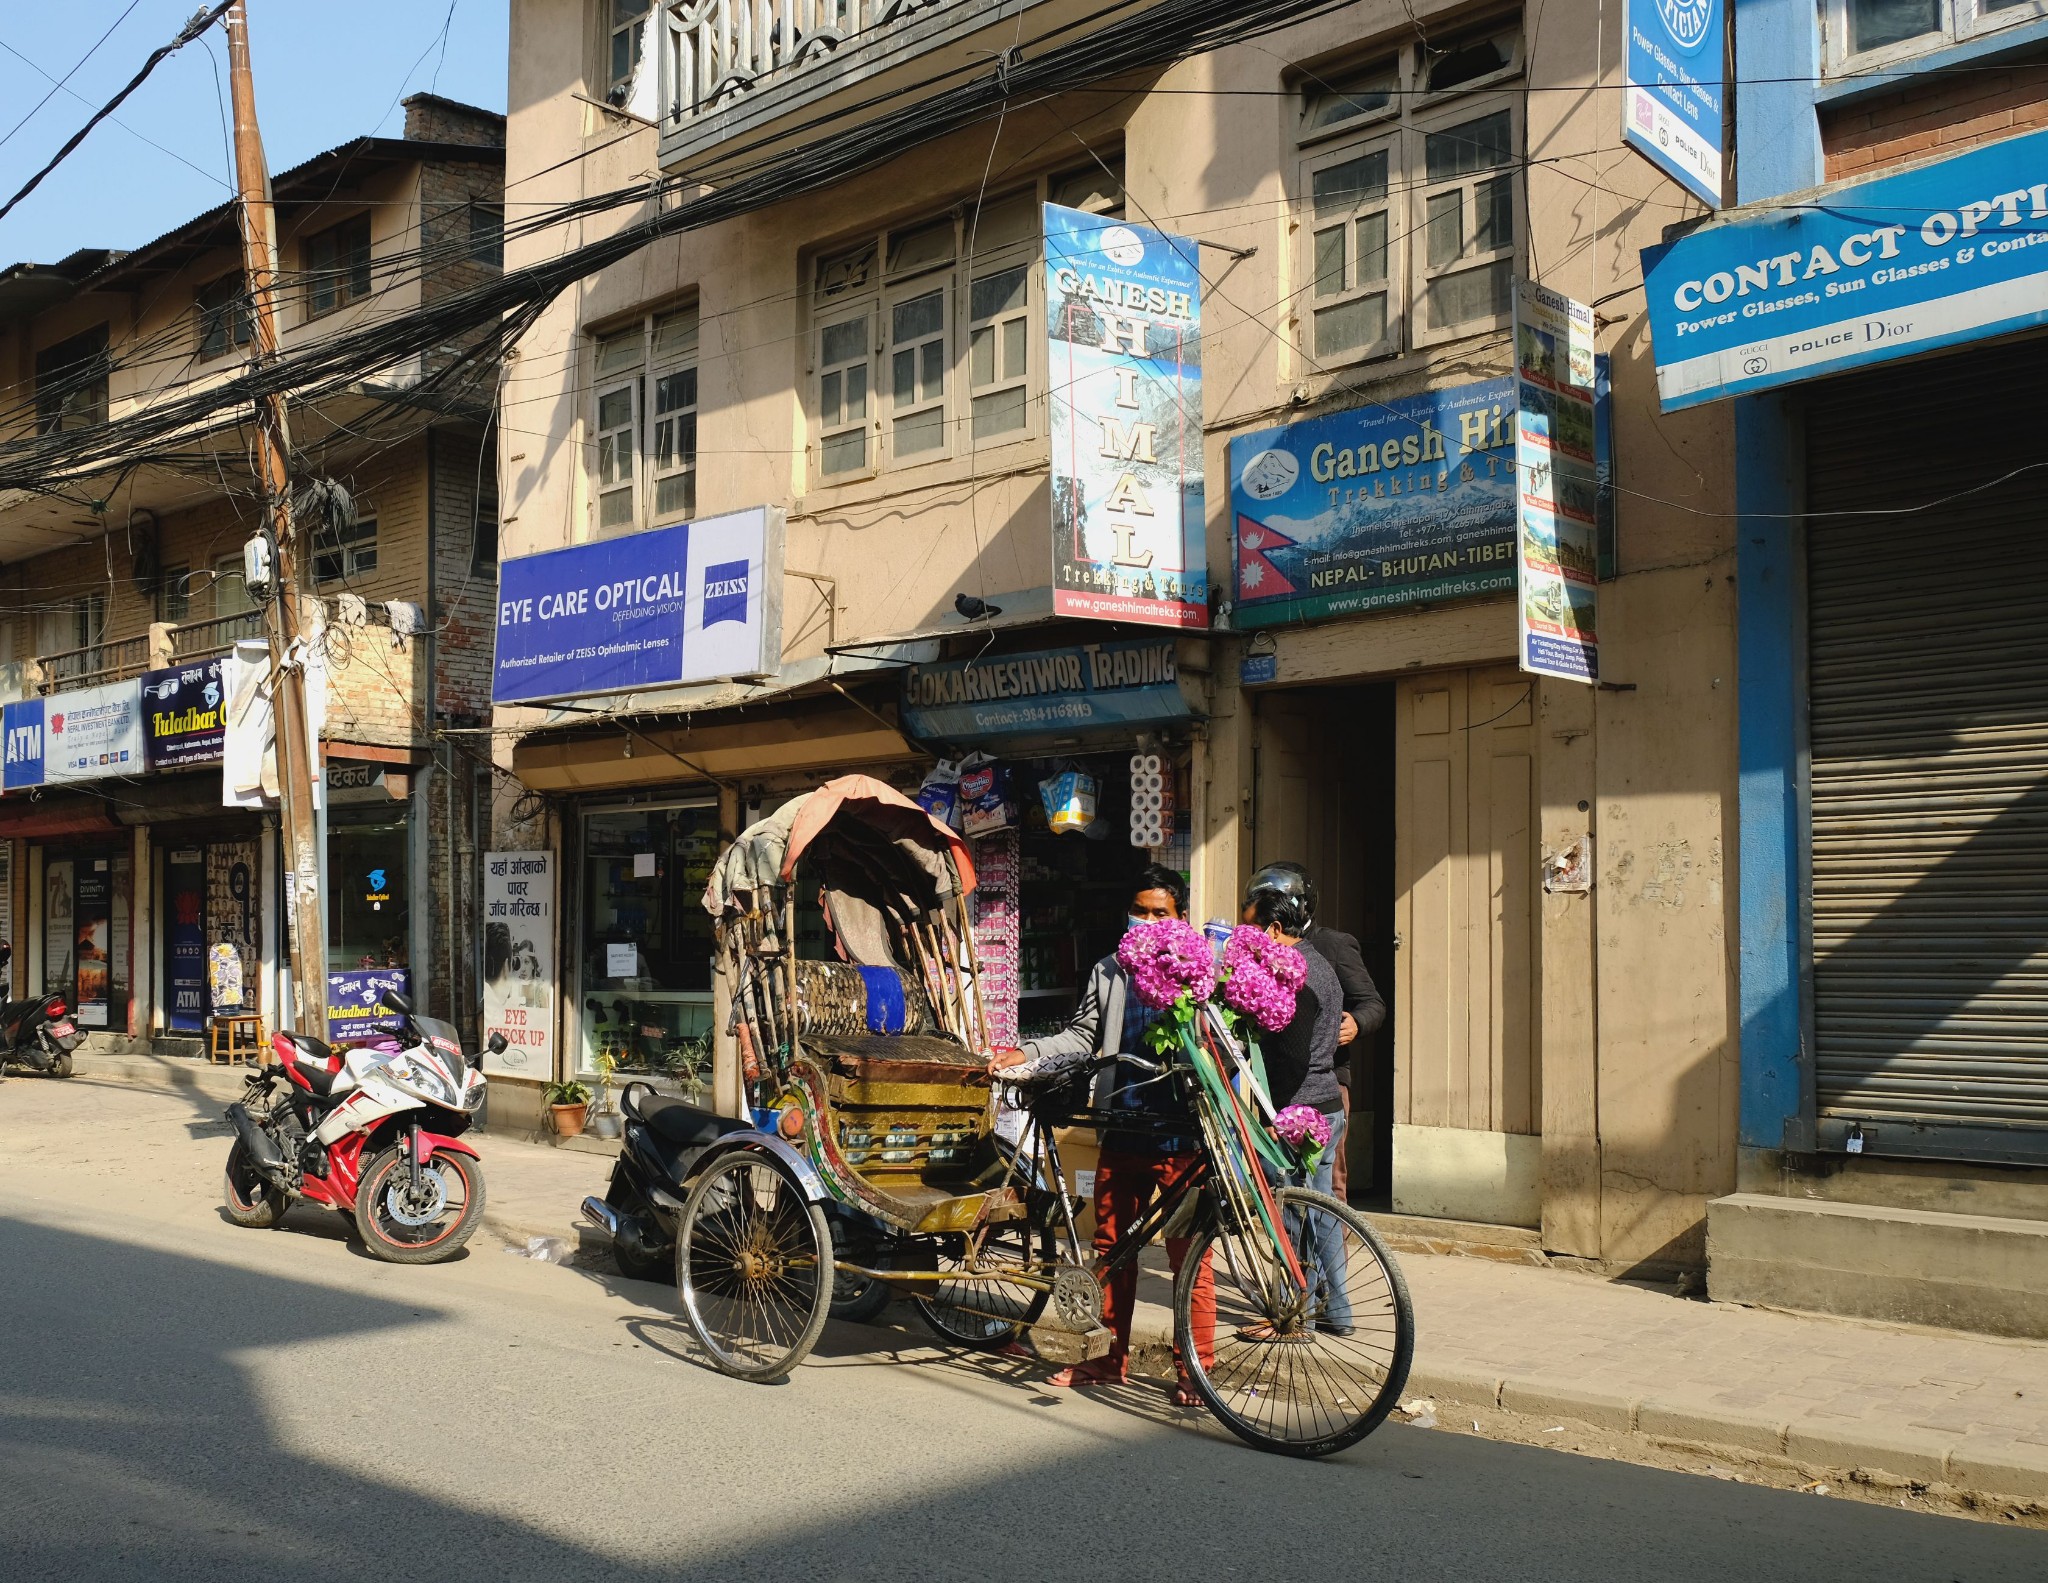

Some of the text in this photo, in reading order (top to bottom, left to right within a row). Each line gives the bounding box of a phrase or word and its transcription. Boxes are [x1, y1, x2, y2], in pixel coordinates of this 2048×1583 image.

[1633, 26, 1719, 114] Power Glasses, Sun Glasses &
[1657, 73, 1699, 121] Contact Lens
[1676, 135, 1697, 159] POLICE
[1700, 152, 1715, 179] Dior
[1674, 183, 2048, 312] CONTACT OPTI
[1055, 267, 1192, 320] GANESH
[1676, 309, 1737, 337] Power
[1742, 291, 1820, 317] Glasses,
[1825, 277, 1866, 299] Sun
[1872, 258, 1950, 285] Glasses
[1956, 249, 1975, 264] &
[1535, 288, 1590, 324] Ganesh Himal
[1789, 331, 1853, 355] POLICE
[1863, 320, 1913, 343] Dior
[1739, 344, 1768, 356] GUCCI
[1386, 413, 1399, 426] for
[1411, 406, 1436, 418] Exotic
[1438, 403, 1446, 411] &
[1447, 394, 1486, 410] Authentic
[1098, 312, 1158, 568] HIMAL
[1310, 420, 1444, 484] Ganesh
[1328, 469, 1449, 507] Trekking
[1460, 463, 1474, 484] &
[1399, 529, 1414, 539] Tel:
[1304, 552, 1331, 567] E-mail:
[705, 577, 747, 599] ZEISS
[1063, 564, 1203, 597] Trekking & Tours
[1311, 569, 1375, 589] NEPAL-
[500, 571, 684, 626] EYE CARE OPTICAL
[1328, 575, 1511, 612] www.ganeshhimaltreks.com
[612, 601, 683, 622] DEFENDING VISION
[1067, 597, 1197, 620] www.ganeshhimaltreks.com
[500, 637, 670, 669] Authorized Retailer of ZEISS Ophthalmic Lenses
[906, 655, 1082, 707] GOKARNESHWOR
[67, 723, 81, 734] NEPAL
[81, 719, 107, 731] INVESTMENT
[107, 717, 120, 727] BANK
[153, 707, 217, 737] Tuladhar
[6, 725, 41, 764] ATM
[68, 761, 77, 769] VISA
[490, 858, 508, 876] यहाँ
[80, 885, 104, 893] DIVINITY
[507, 881, 528, 896] पावर
[489, 899, 508, 917] जाँच
[509, 899, 540, 917] गरिन्छ
[177, 991, 200, 1007] ATM
[504, 1009, 527, 1025] EYE
[530, 1031, 544, 1046] UP
